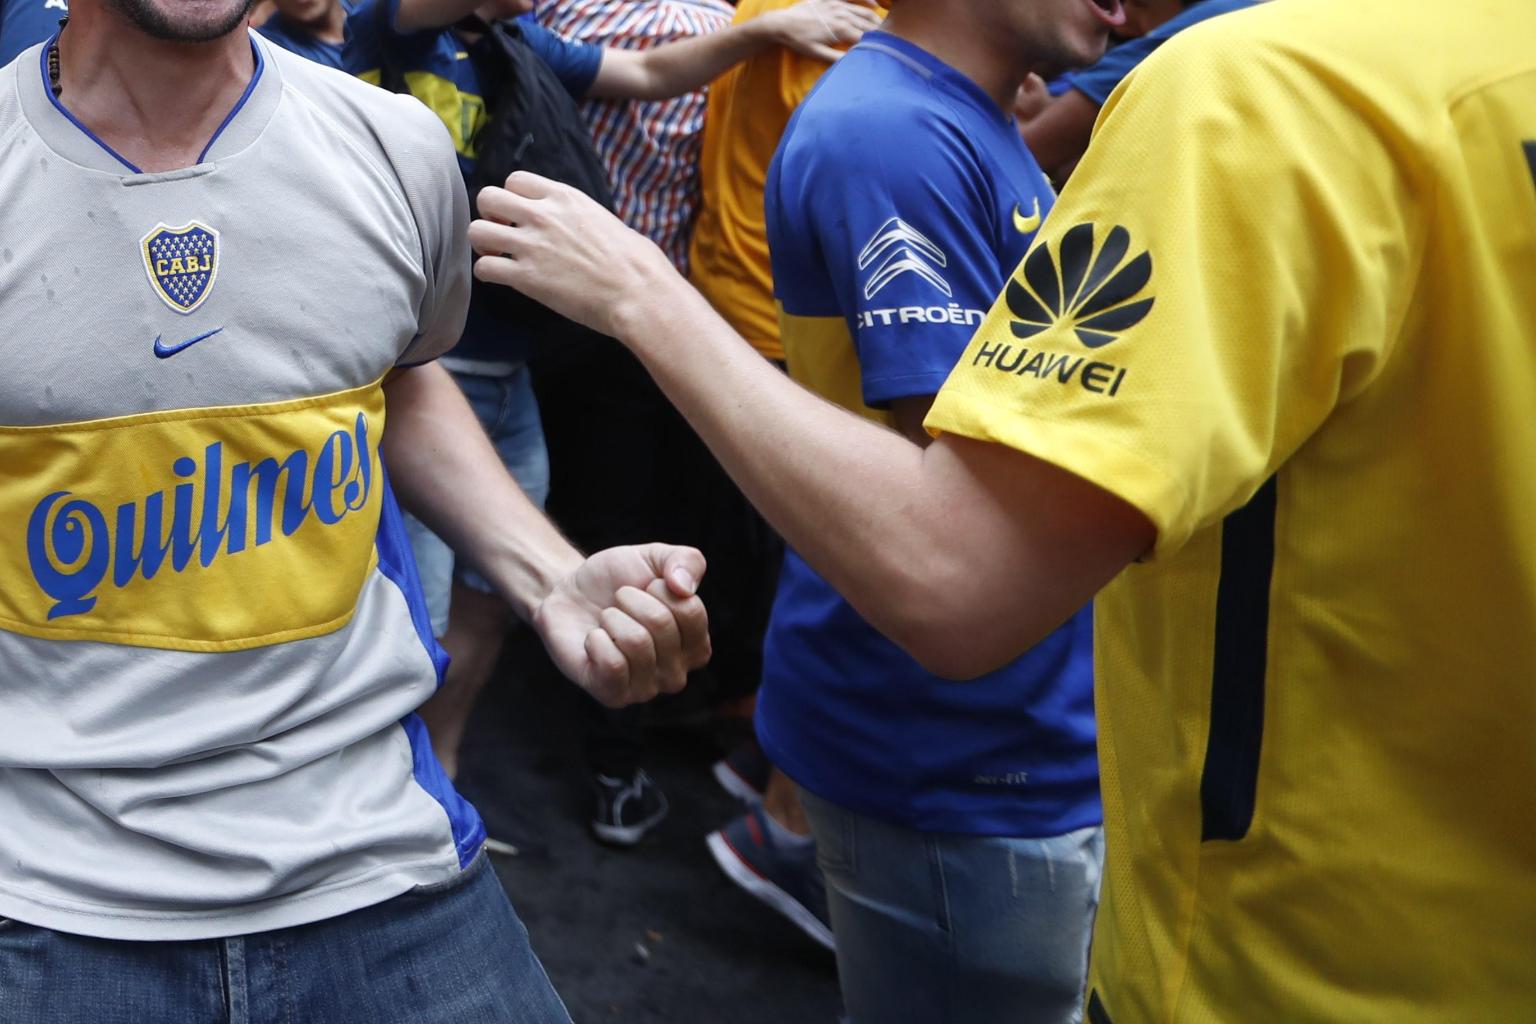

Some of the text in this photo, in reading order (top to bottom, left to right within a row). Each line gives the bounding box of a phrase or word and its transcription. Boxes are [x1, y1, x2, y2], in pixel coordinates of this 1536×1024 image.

[156, 254, 211, 276] CABJ
[972, 341, 1127, 397] HUAWEI
[26, 410, 372, 621] Quilmes
